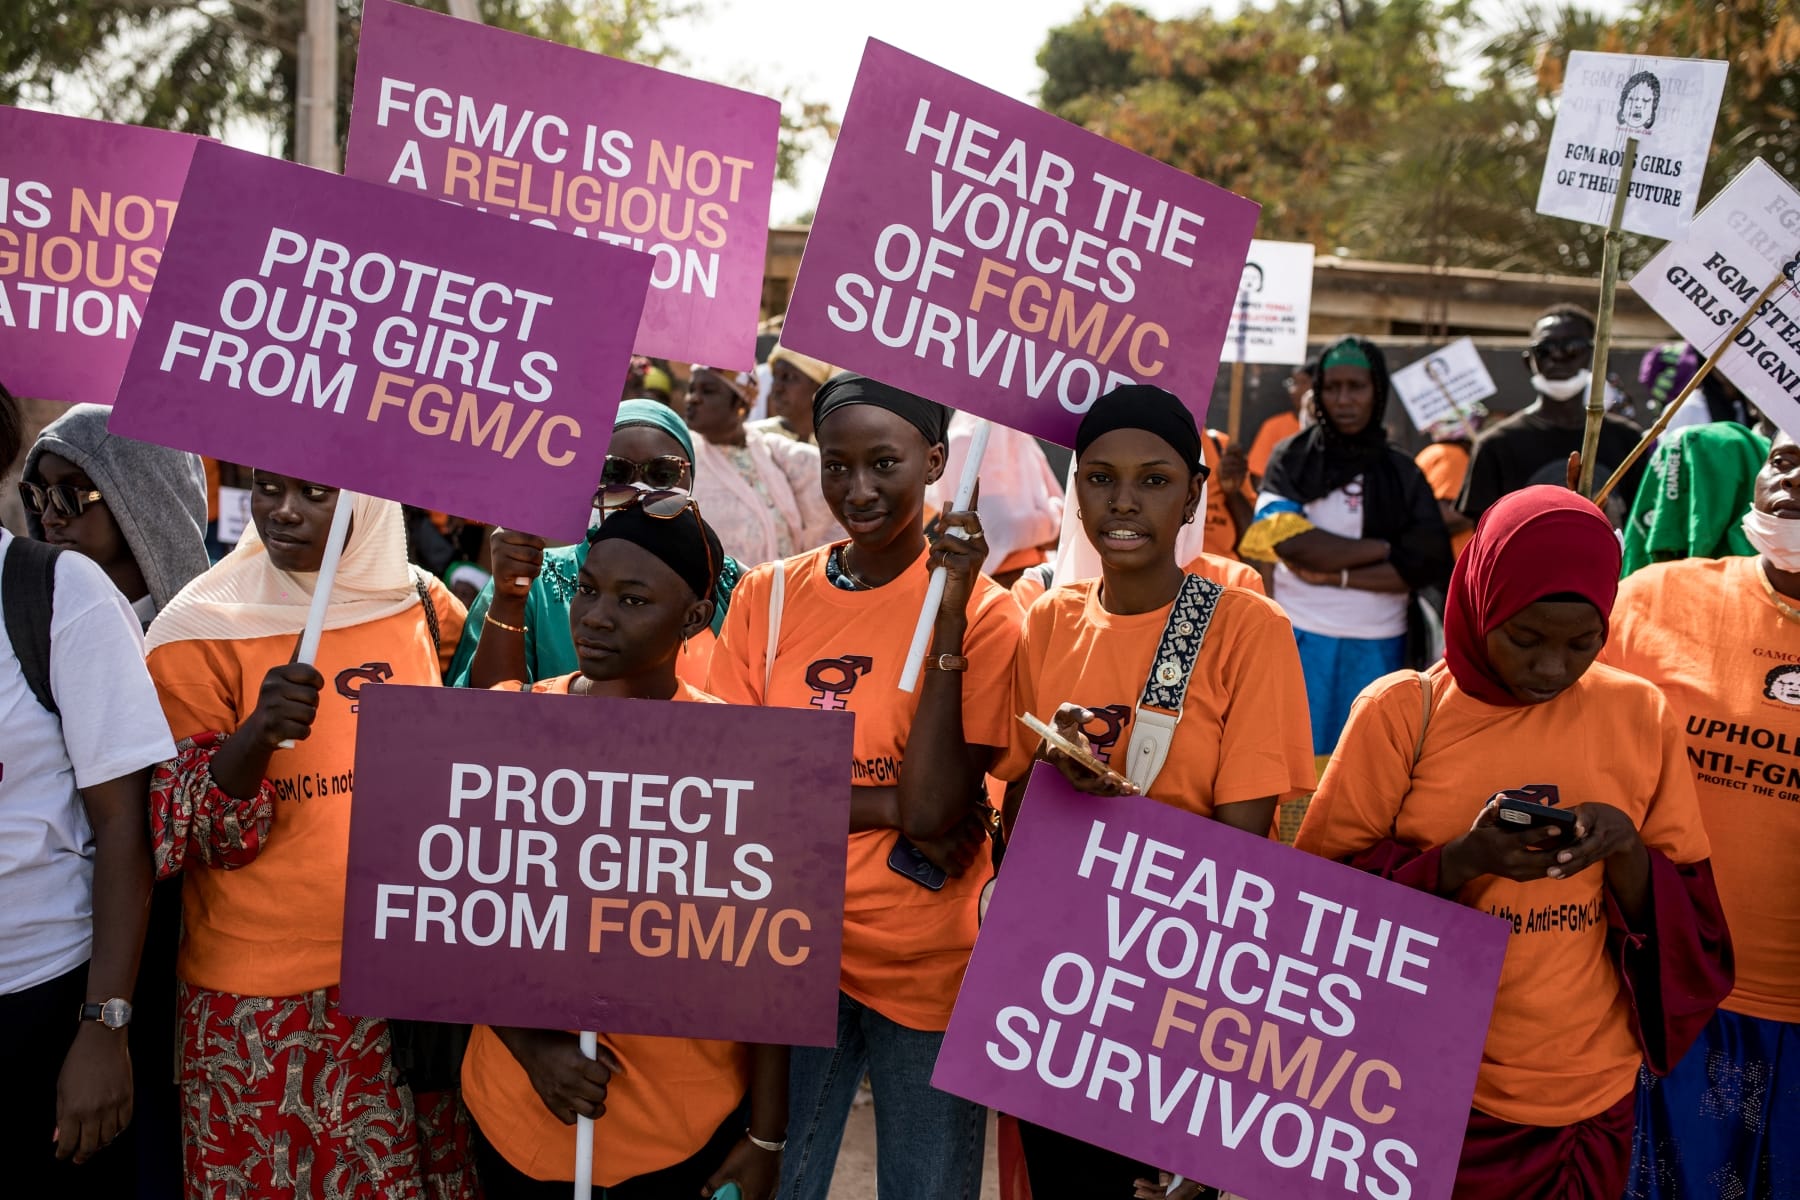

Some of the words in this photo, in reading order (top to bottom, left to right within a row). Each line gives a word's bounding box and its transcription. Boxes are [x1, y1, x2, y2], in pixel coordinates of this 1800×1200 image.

[376, 77, 569, 165] FGM/C
[583, 124, 634, 179] IS
[647, 139, 753, 203] NOT
[388, 140, 427, 190] A
[443, 147, 729, 249] RELIGIOUS
[905, 97, 1075, 216] HEAR
[1093, 172, 1205, 267] THE
[1557, 169, 1576, 186] OF
[1627, 182, 1683, 208] FUTURE
[1565, 143, 1597, 163] FGM
[1641, 155, 1683, 177] GIRLS
[258, 226, 554, 342] PROTECT
[931, 170, 1142, 303] VOICES
[1703, 251, 1759, 304] FGM
[220, 278, 358, 356] OUR
[372, 316, 558, 403] GIRLS
[874, 223, 965, 293] OF
[969, 257, 1170, 377] FGM/C
[160, 320, 358, 415] FROM
[366, 371, 582, 468] FGM/C
[1734, 326, 1800, 405] DIGNI
[1666, 452, 1681, 500] CHANGE
[271, 773, 313, 803] GM/C
[316, 772, 328, 798] is
[332, 769, 353, 795] not
[448, 762, 755, 836] PROTECT
[1697, 772, 1748, 791] PROTECT
[1752, 784, 1775, 798] THE
[418, 824, 559, 888] OUR
[578, 833, 775, 901] GIRLS
[1078, 820, 1276, 940] HEAR
[1298, 890, 1439, 995] THE
[374, 883, 569, 951] FROM
[588, 896, 812, 967] FGM/C
[1106, 894, 1362, 1037] VOICES
[1040, 952, 1146, 1028] OF
[1151, 987, 1402, 1125] FGM/C
[986, 1006, 1418, 1200] SURVIVORS
